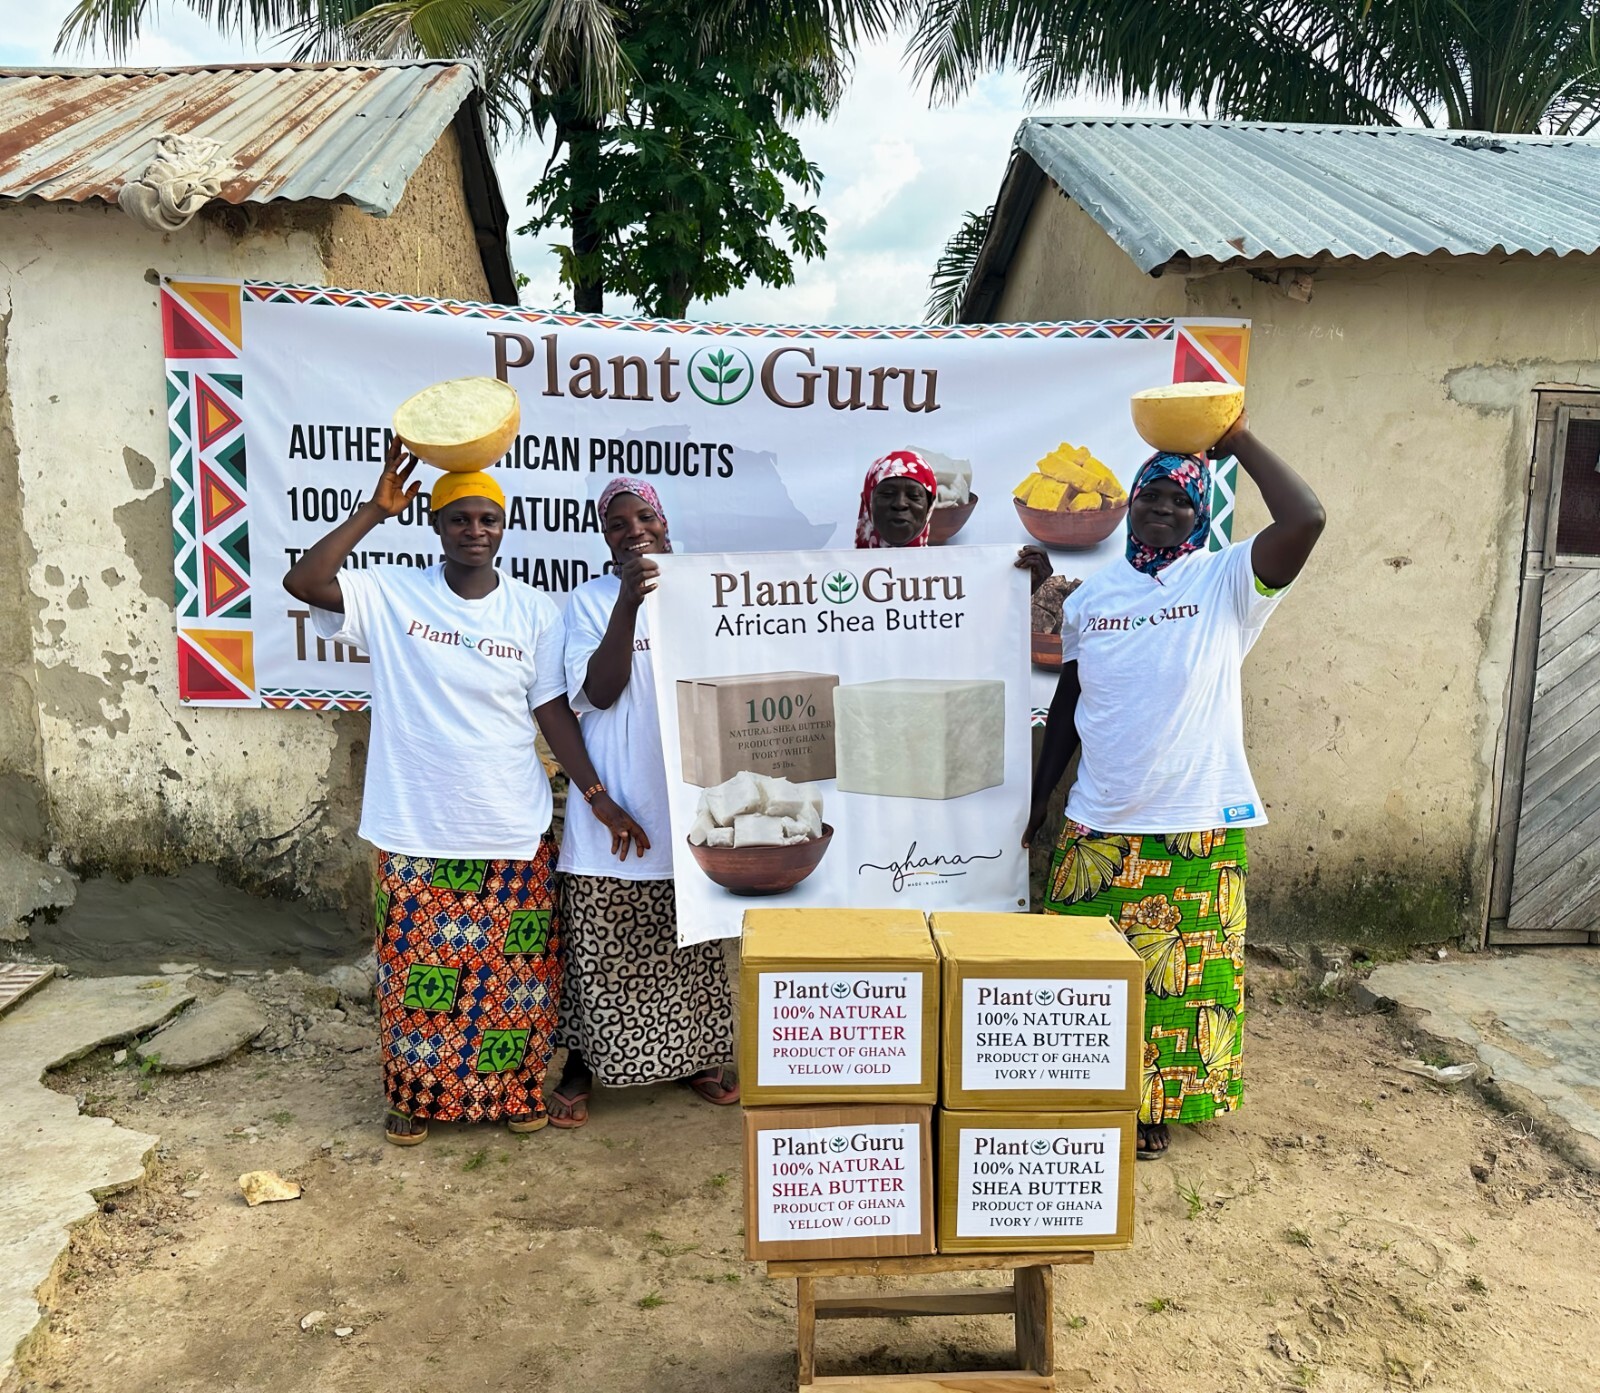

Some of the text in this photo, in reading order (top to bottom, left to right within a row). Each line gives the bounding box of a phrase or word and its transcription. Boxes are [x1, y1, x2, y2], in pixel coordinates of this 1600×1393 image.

[487, 331, 941, 414] Plant Guru
[289, 424, 395, 462] AUTHE
[590, 438, 734, 479] PRODUCTS
[503, 495, 600, 534] ATURA
[710, 567, 966, 608] Plant Guru
[715, 608, 965, 637] African Shea Butter
[1149, 604, 1200, 626] Guru
[406, 619, 523, 661] Plant Guru
[746, 693, 816, 724] 100%
[729, 720, 832, 739] NATURAL SHEA BUTTER
[738, 733, 826, 750] PRODUCT OF GHANA
[751, 750, 780, 760] IVORY
[784, 746, 813, 756] WHITE
[858, 840, 1003, 893] ghana
[773, 980, 907, 999] Plant Guru
[977, 987, 1112, 1006] Plant Guru
[773, 1005, 907, 1020] 100% NATURAL
[977, 1012, 1111, 1026] 100% NATURAL
[772, 1026, 907, 1041] SHEA BUTTER
[976, 1032, 1110, 1047] SHEA BUTTER
[773, 1047, 907, 1058] PRODUCT OF GHANA
[977, 1053, 1111, 1063] PRODUCT OF GHANA
[788, 1064, 844, 1074] YELLOW
[854, 1063, 891, 1074] GOLD
[995, 1069, 1037, 1079] IVORY
[1048, 1069, 1090, 1079] WHITE
[772, 1133, 904, 1156] Plant Guru
[973, 1136, 1105, 1156] Plant Guru
[772, 1157, 905, 1176] 100% NATURAL
[973, 1161, 1105, 1175] 100% NATURAL
[772, 1177, 905, 1198] SHEA BUTTER
[972, 1181, 1103, 1196] SHEA BUTTER
[773, 1198, 906, 1214] PRODUCT OF GHANA
[972, 1200, 1103, 1211] PRODUCT OF GHANA
[788, 1217, 844, 1230] YELLOW
[854, 1215, 891, 1226] GOLD
[989, 1217, 1031, 1227] IVORY
[1042, 1216, 1084, 1226] WHITE
